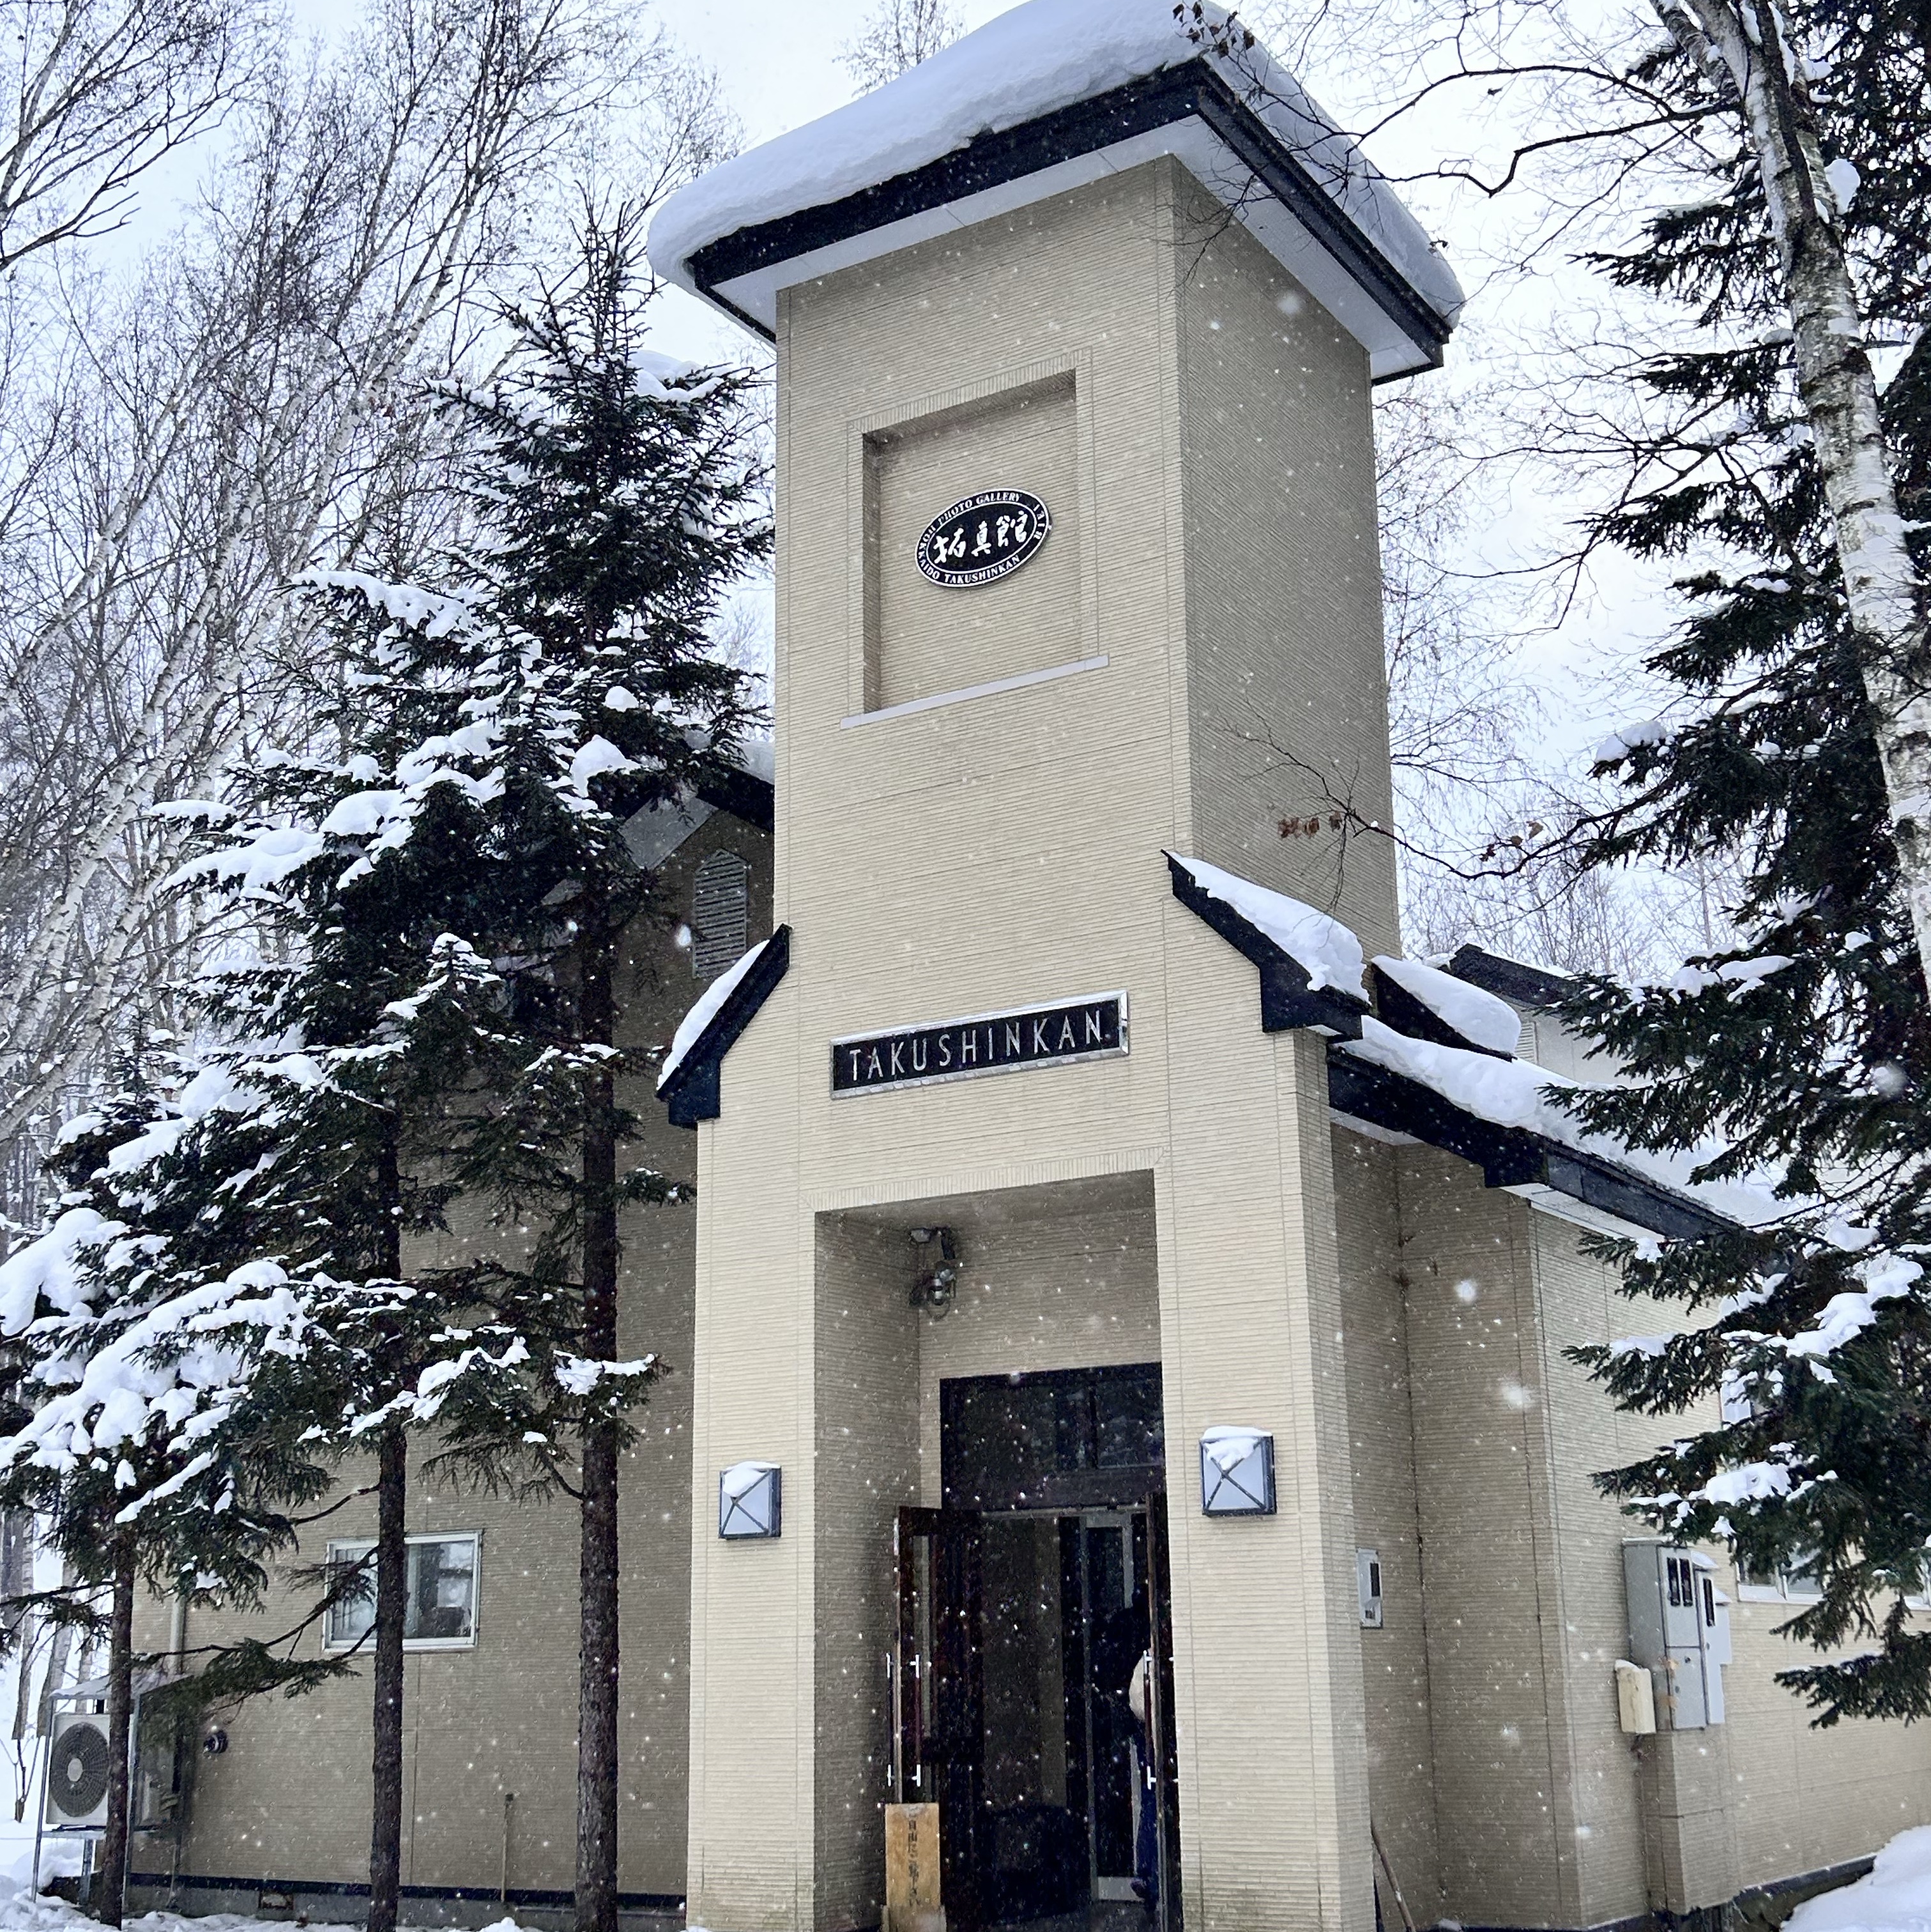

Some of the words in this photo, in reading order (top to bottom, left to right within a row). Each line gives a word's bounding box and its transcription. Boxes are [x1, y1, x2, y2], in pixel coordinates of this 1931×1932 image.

[938, 499, 972, 524] PHOTO
[975, 492, 1022, 505] GALLERY
[944, 554, 1021, 584] TAKUSHINKAN
[850, 1010, 1102, 1081] TAKUSHINKAN
